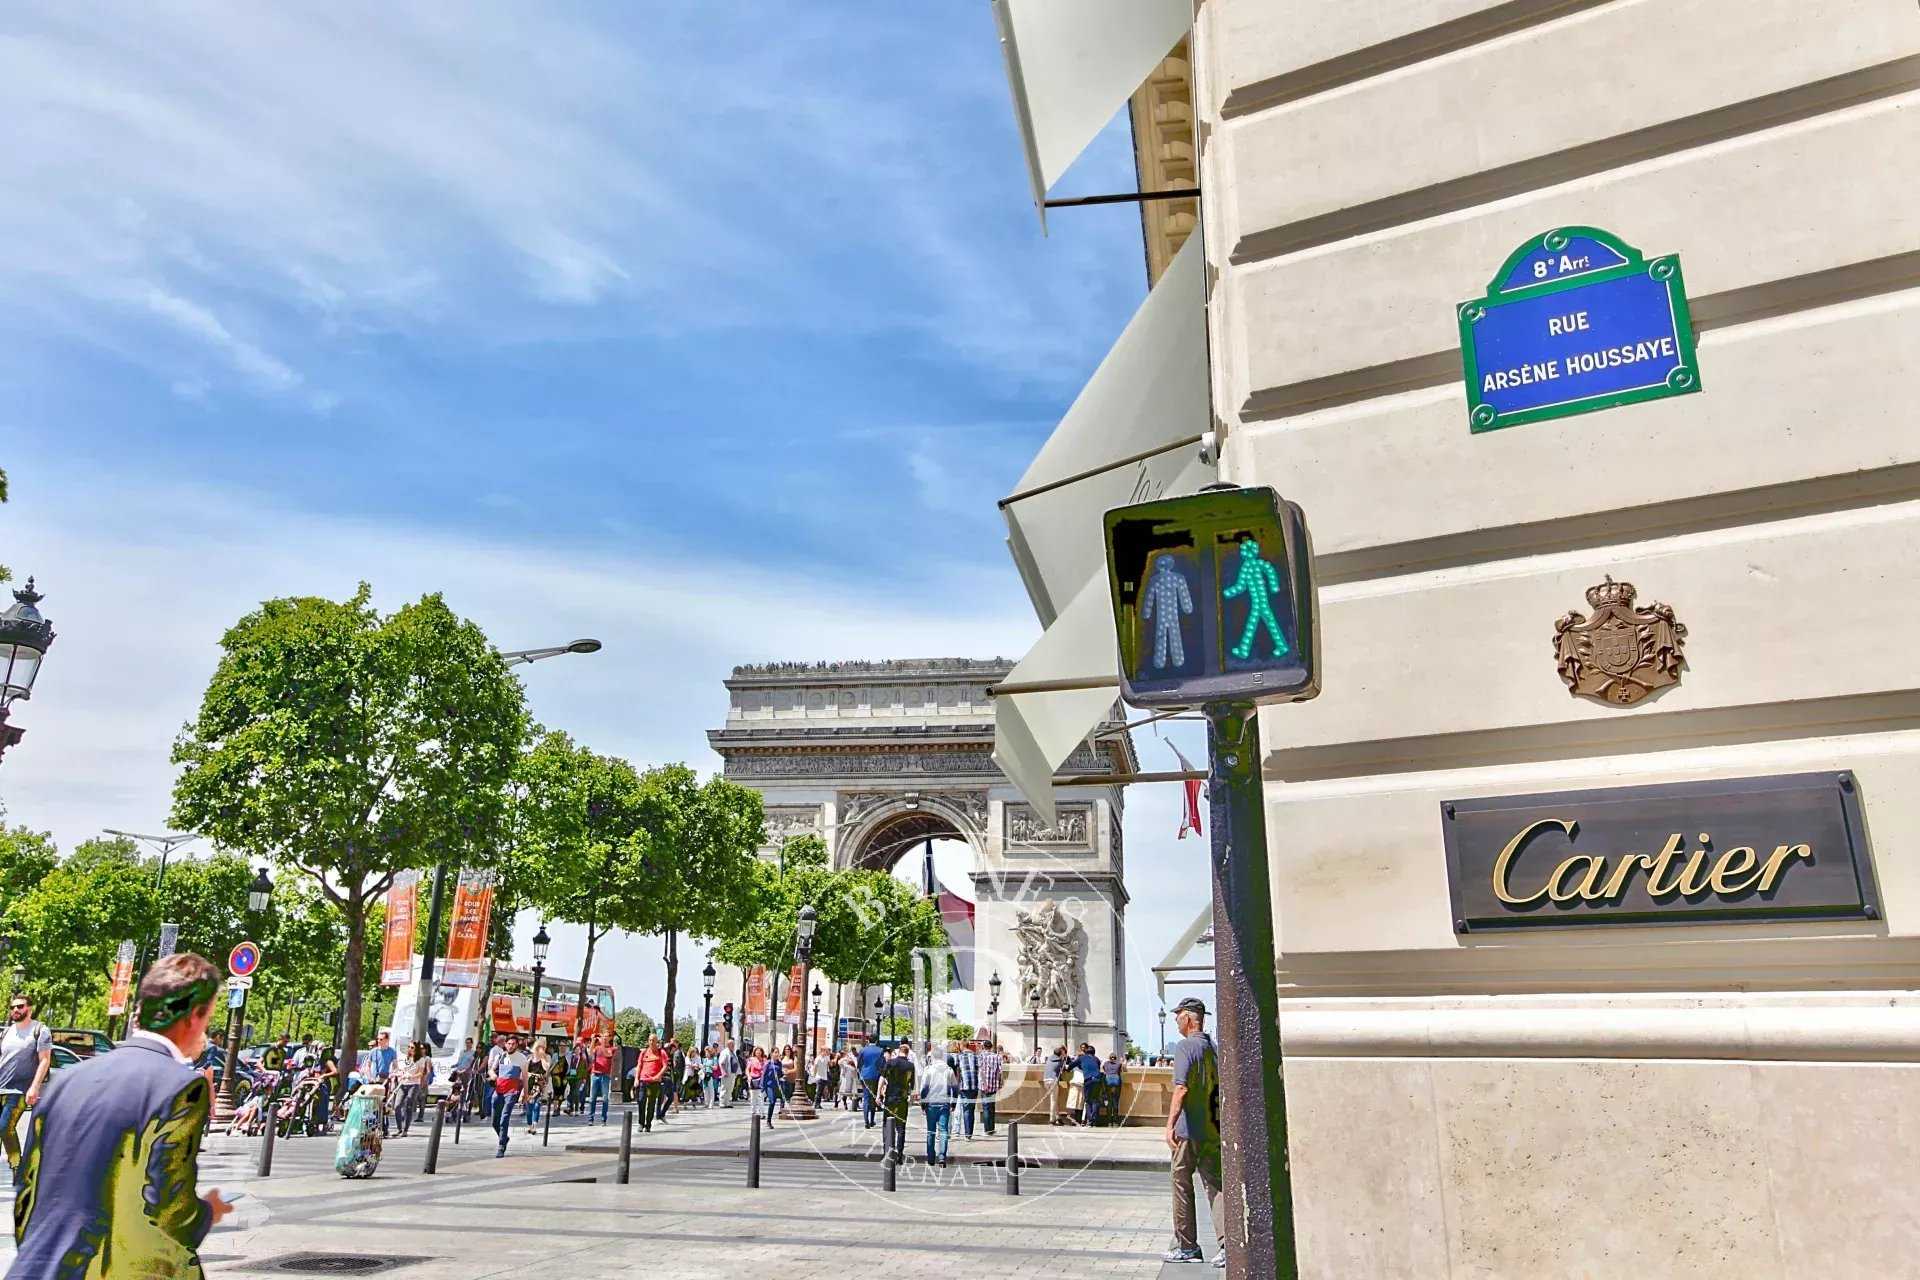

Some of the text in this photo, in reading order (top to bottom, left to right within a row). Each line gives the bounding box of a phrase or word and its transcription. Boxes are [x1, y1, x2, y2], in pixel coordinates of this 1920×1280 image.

[1548, 311, 1590, 336] RUE
[1483, 337, 1675, 392] ARSÈNE HOUSSAYE
[1491, 817, 1811, 905] Cartier
